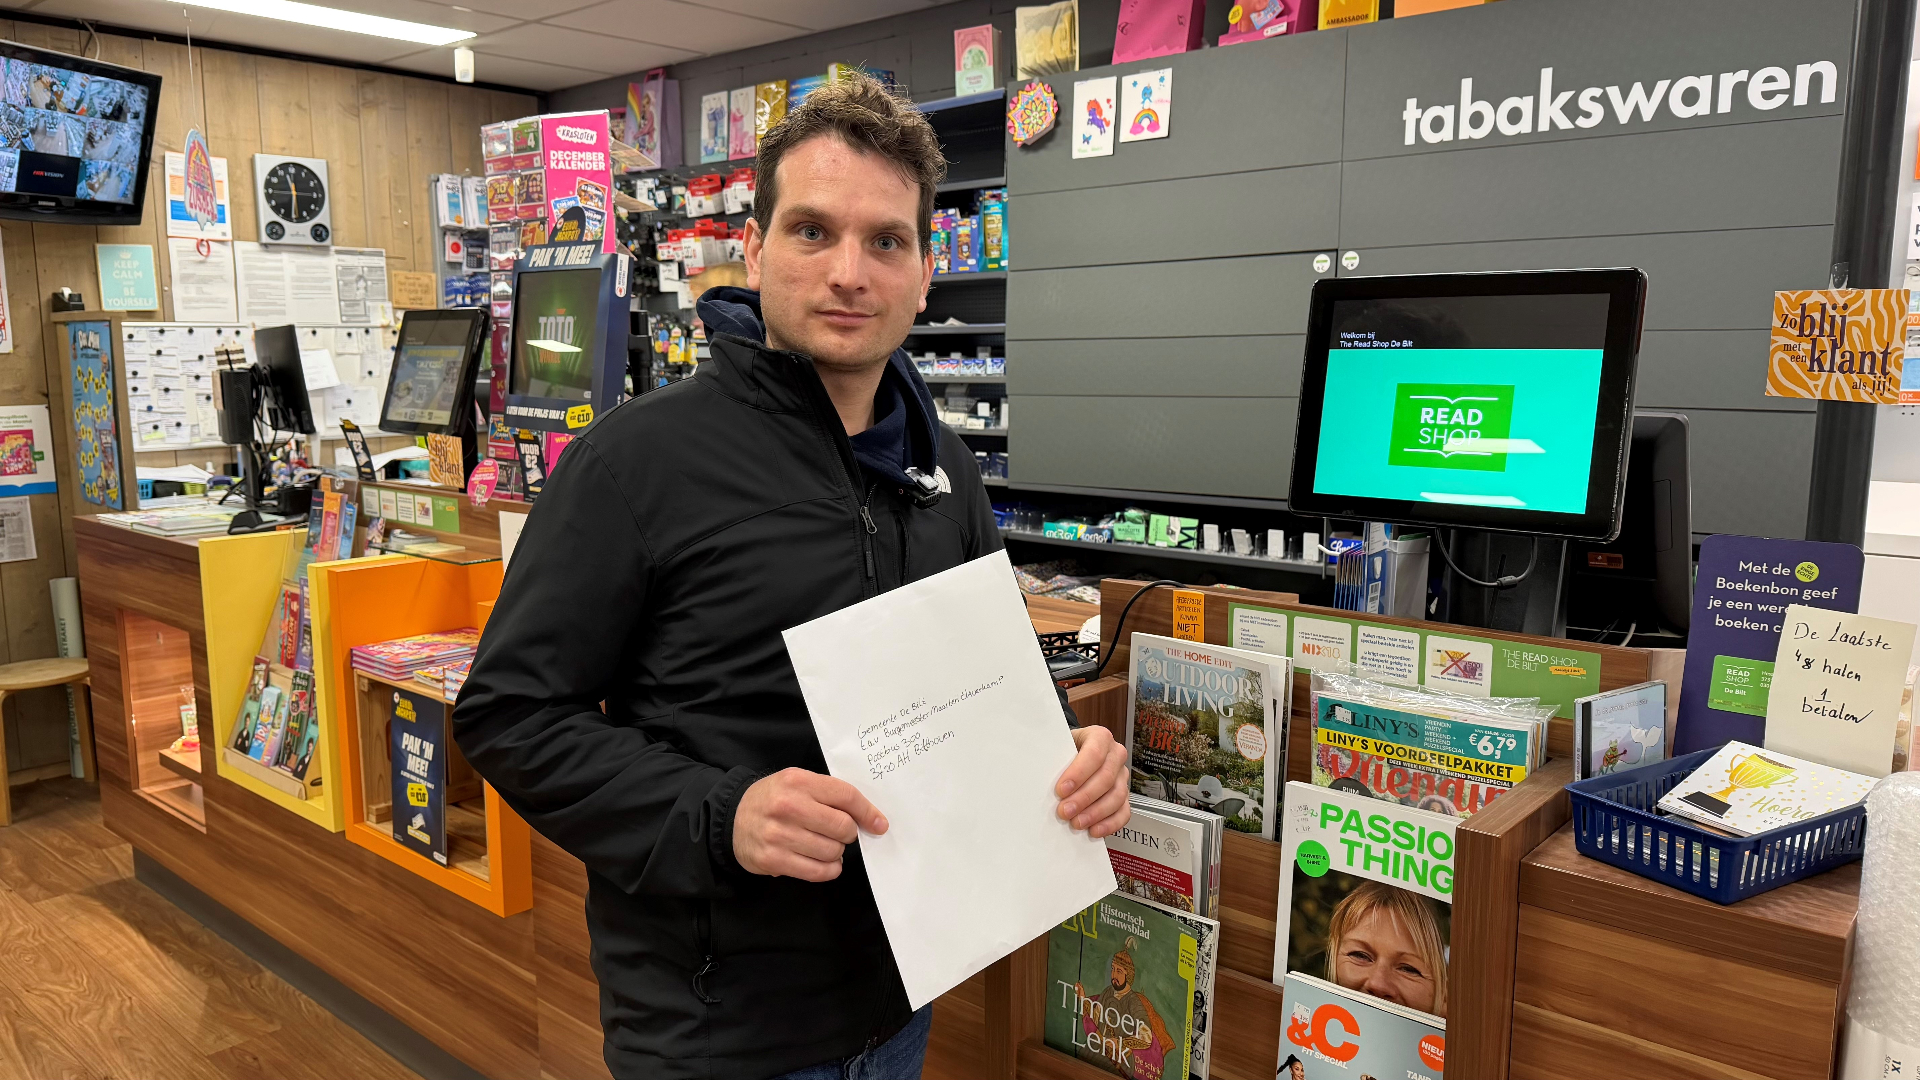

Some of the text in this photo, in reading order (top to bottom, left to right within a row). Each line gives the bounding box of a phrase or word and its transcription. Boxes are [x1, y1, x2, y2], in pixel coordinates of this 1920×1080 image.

[1327, 14, 1368, 25] AMBASSADOR
[1403, 60, 1837, 145] tabakswaren
[562, 128, 594, 141] KRASLOTEN
[550, 150, 604, 162] DECEMBER
[550, 160, 605, 171] KALENDER
[114, 260, 140, 268] KEEP
[529, 248, 555, 268] PAK
[565, 244, 596, 265] MEE!
[113, 270, 142, 279] CALM
[123, 287, 136, 296] BE
[107, 298, 153, 306] YOURSELF
[539, 316, 574, 344] TOTO
[1781, 314, 1797, 329] Zo
[1797, 302, 1848, 349] blij
[1783, 342, 1801, 352] met
[1790, 354, 1807, 363] een
[1807, 338, 1891, 376] klant
[1852, 376, 1892, 396] als jij!
[549, 409, 560, 420] VAN
[577, 413, 590, 423] €10
[1420, 407, 1483, 426] READ
[1418, 427, 1481, 446] SHOP
[520, 443, 540, 455] VOOR
[440, 460, 460, 474] klant
[1739, 560, 1791, 576] Met de
[1716, 577, 1839, 601] Boekenbon geef
[1707, 596, 1796, 614] je een were
[1177, 622, 1200, 633] NIET
[1715, 614, 1769, 632] boeken
[1794, 622, 1820, 640] De
[1166, 647, 1181, 658] THE
[1184, 651, 1212, 665] HOME
[1302, 643, 1340, 659] NIX18
[1502, 649, 1577, 667] THE READ SHOP
[1507, 659, 1538, 672] DE BILT
[1727, 669, 1750, 677] READ
[1822, 658, 1861, 682] halen
[1144, 657, 1252, 701] OUTDOOR
[1726, 675, 1749, 683] SHOP
[1163, 682, 1234, 718] LIVING
[1802, 697, 1869, 723] betalen
[858, 713, 897, 739] Gemeente
[884, 711, 929, 738] Burgemeester
[1350, 712, 1419, 738] LINY'S
[401, 732, 422, 756] PAK
[901, 732, 921, 747] 300
[1150, 730, 1181, 753] BIG
[1424, 731, 1451, 739] WEEKEND
[1424, 737, 1450, 745] WEEKEND
[1326, 732, 1513, 779] LINY'S VOORDEELPAKKET
[1424, 742, 1465, 754] PUZZELSPECIAL
[407, 753, 429, 778] MEE!
[898, 750, 910, 767] AH
[1389, 758, 1511, 787] DEZE WEEK EXTRA WEEKEND PUZZELSPECIAL
[1320, 802, 1453, 860] PASSIO
[1339, 837, 1454, 894] THING
[1100, 902, 1145, 928] Historisch
[1100, 913, 1150, 940] Nieuwsblad
[1057, 980, 1145, 1039] Timoer
[1072, 1018, 1131, 1068] Lenk
[1135, 1055, 1143, 1065] De
[1301, 1046, 1349, 1070] FIT SPECIAL
[1135, 1066, 1144, 1075] van
